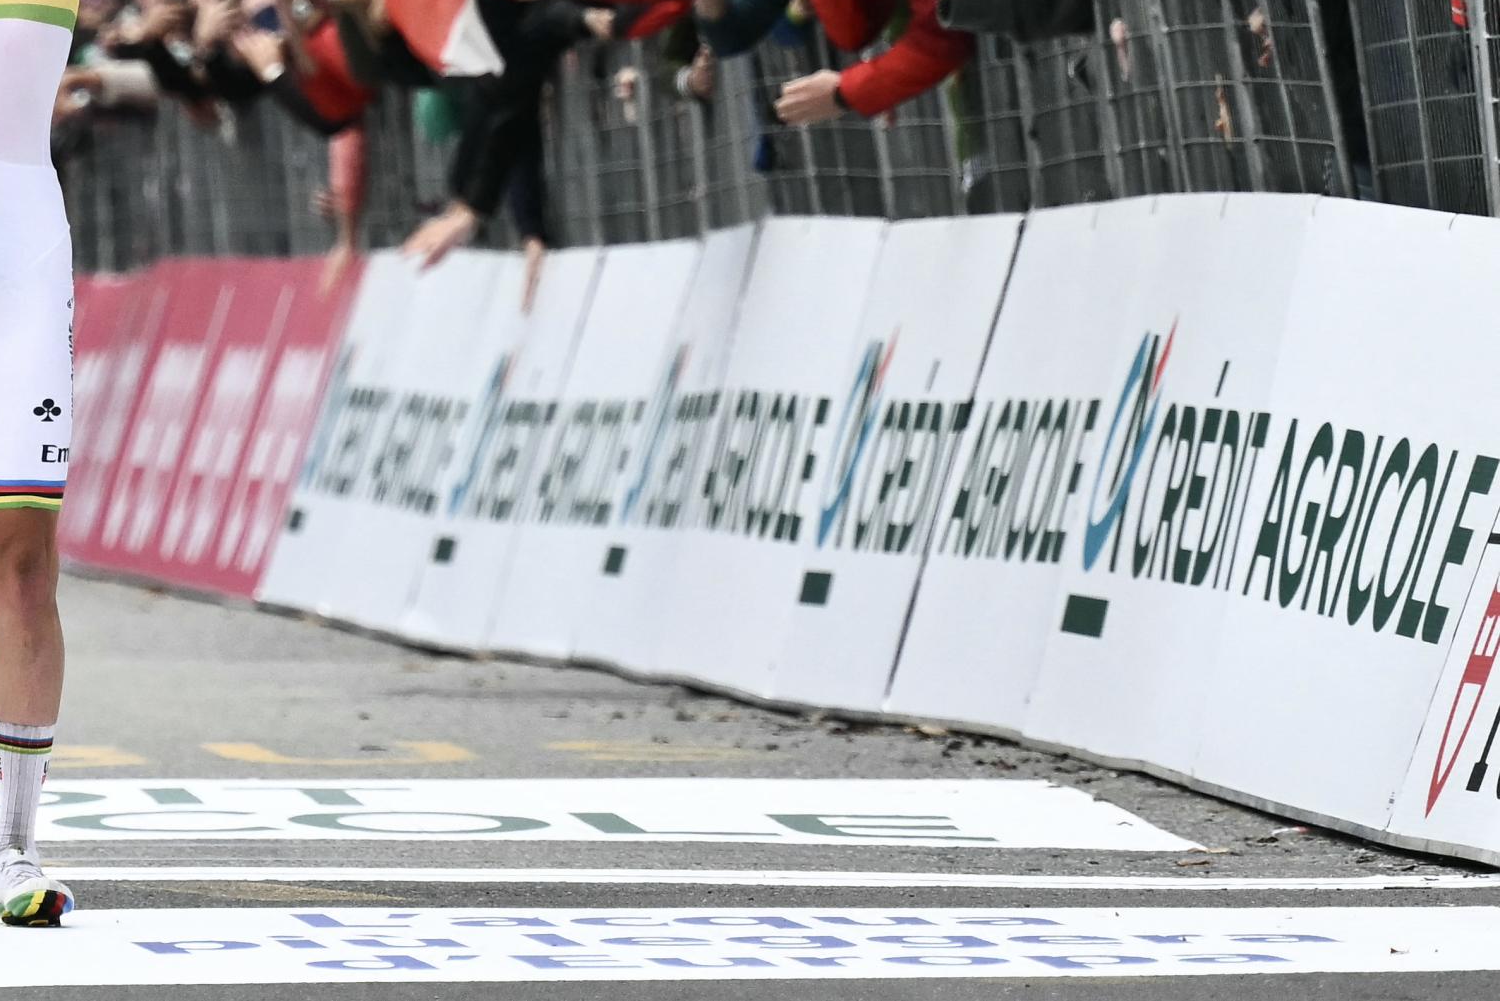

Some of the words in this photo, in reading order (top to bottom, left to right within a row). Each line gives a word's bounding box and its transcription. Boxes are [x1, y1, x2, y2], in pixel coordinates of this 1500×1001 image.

[1132, 360, 1270, 592] CRÉDIT
[1242, 418, 1499, 645] AGRICOLE
[288, 912, 1066, 930] L'acqua
[133, 933, 468, 955] più
[521, 932, 1342, 950] leggera
[306, 953, 1295, 970] d'Europa
